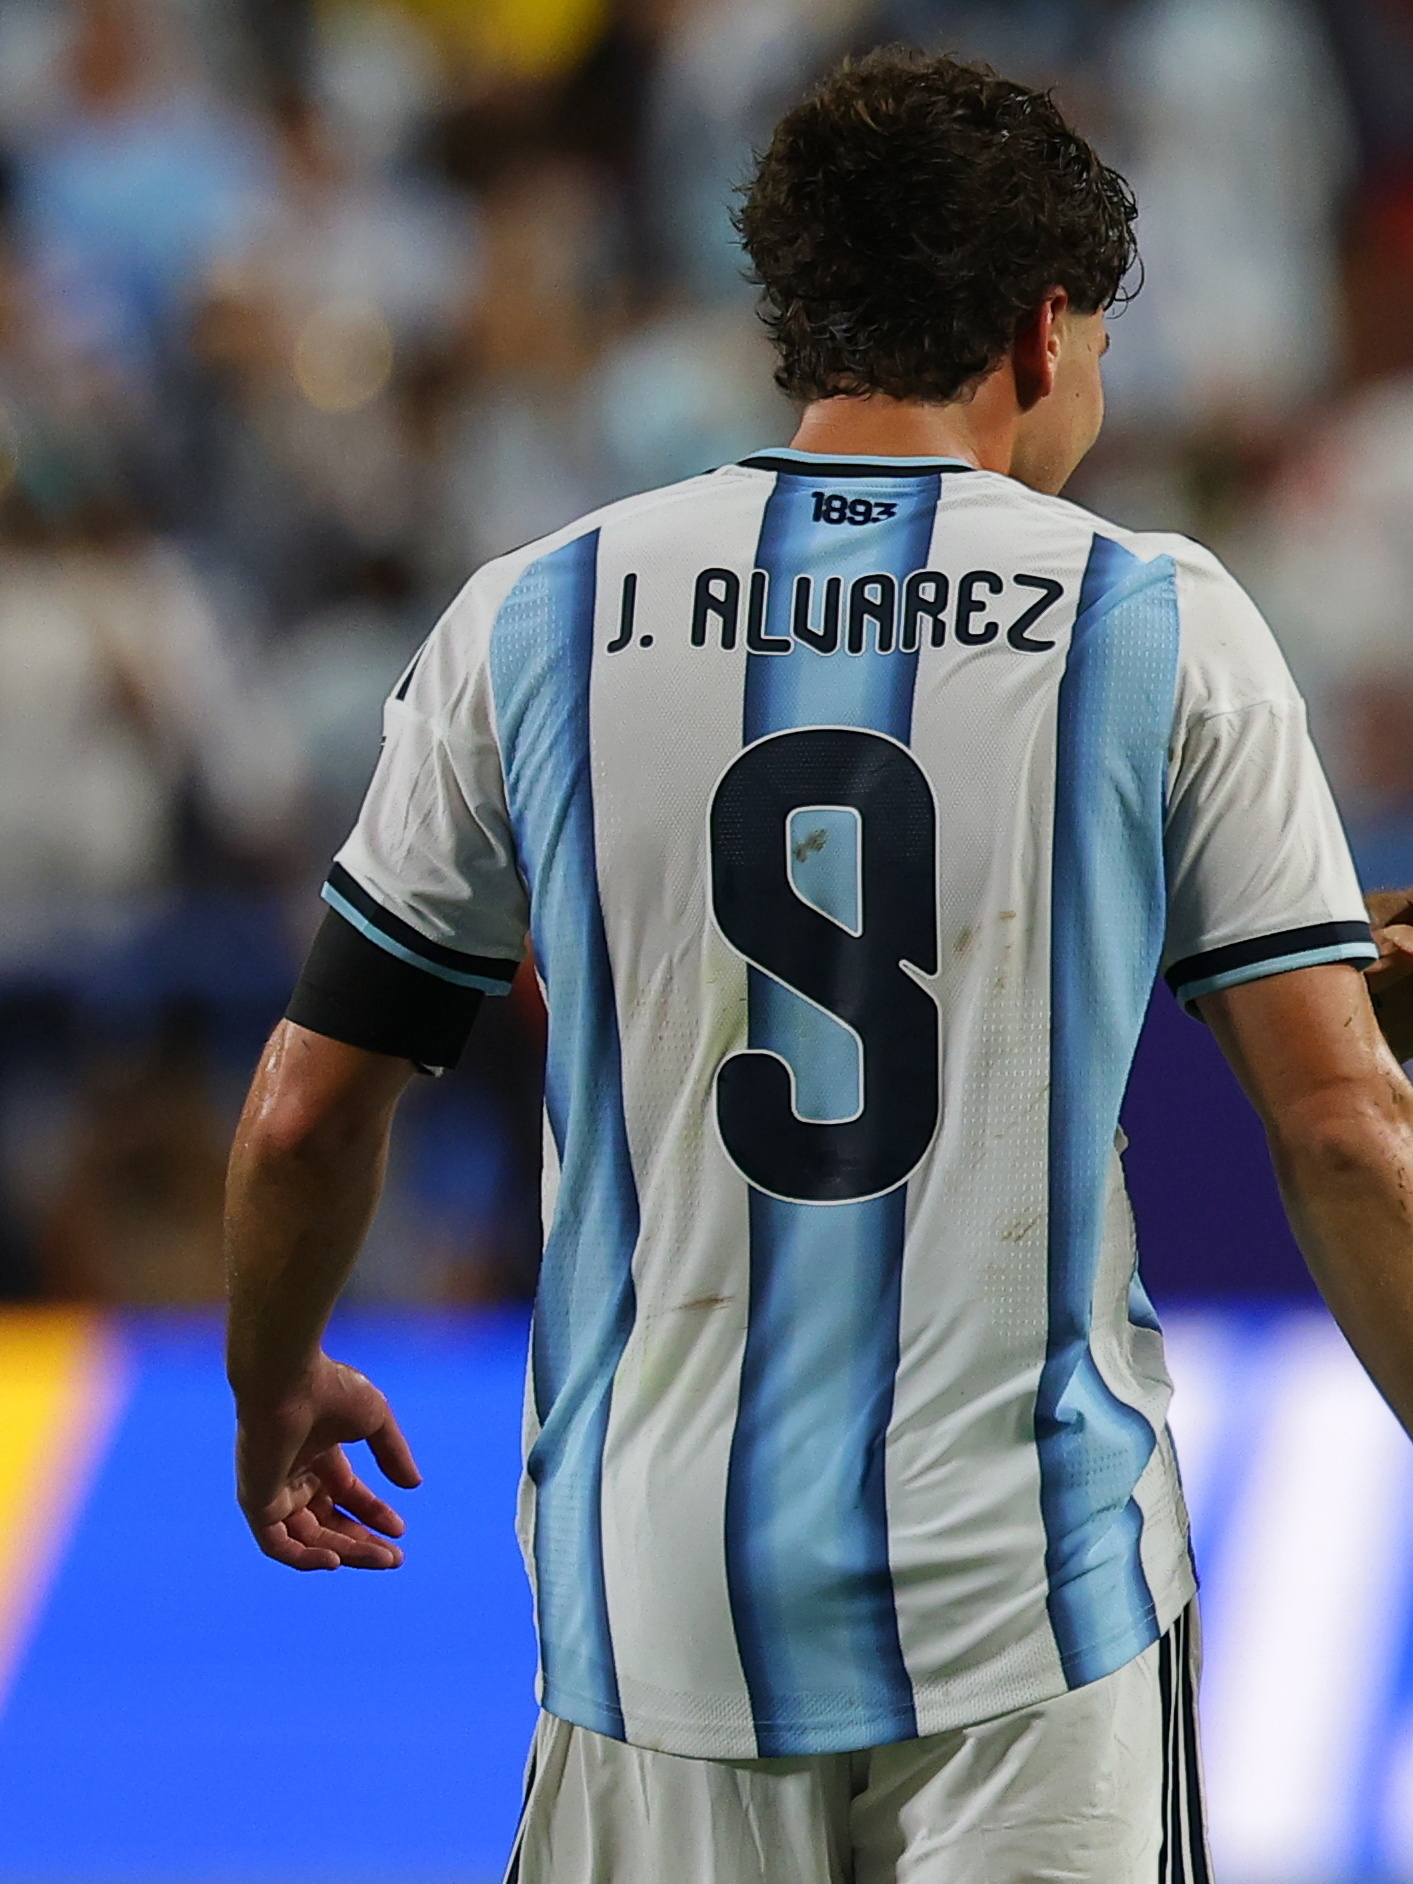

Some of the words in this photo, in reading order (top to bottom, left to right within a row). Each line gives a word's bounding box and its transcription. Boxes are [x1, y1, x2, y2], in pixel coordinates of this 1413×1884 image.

[811, 491, 898, 526] 1893
[606, 571, 655, 654] J.
[689, 567, 1064, 656] ALVAREZ
[706, 725, 943, 1206] 9
